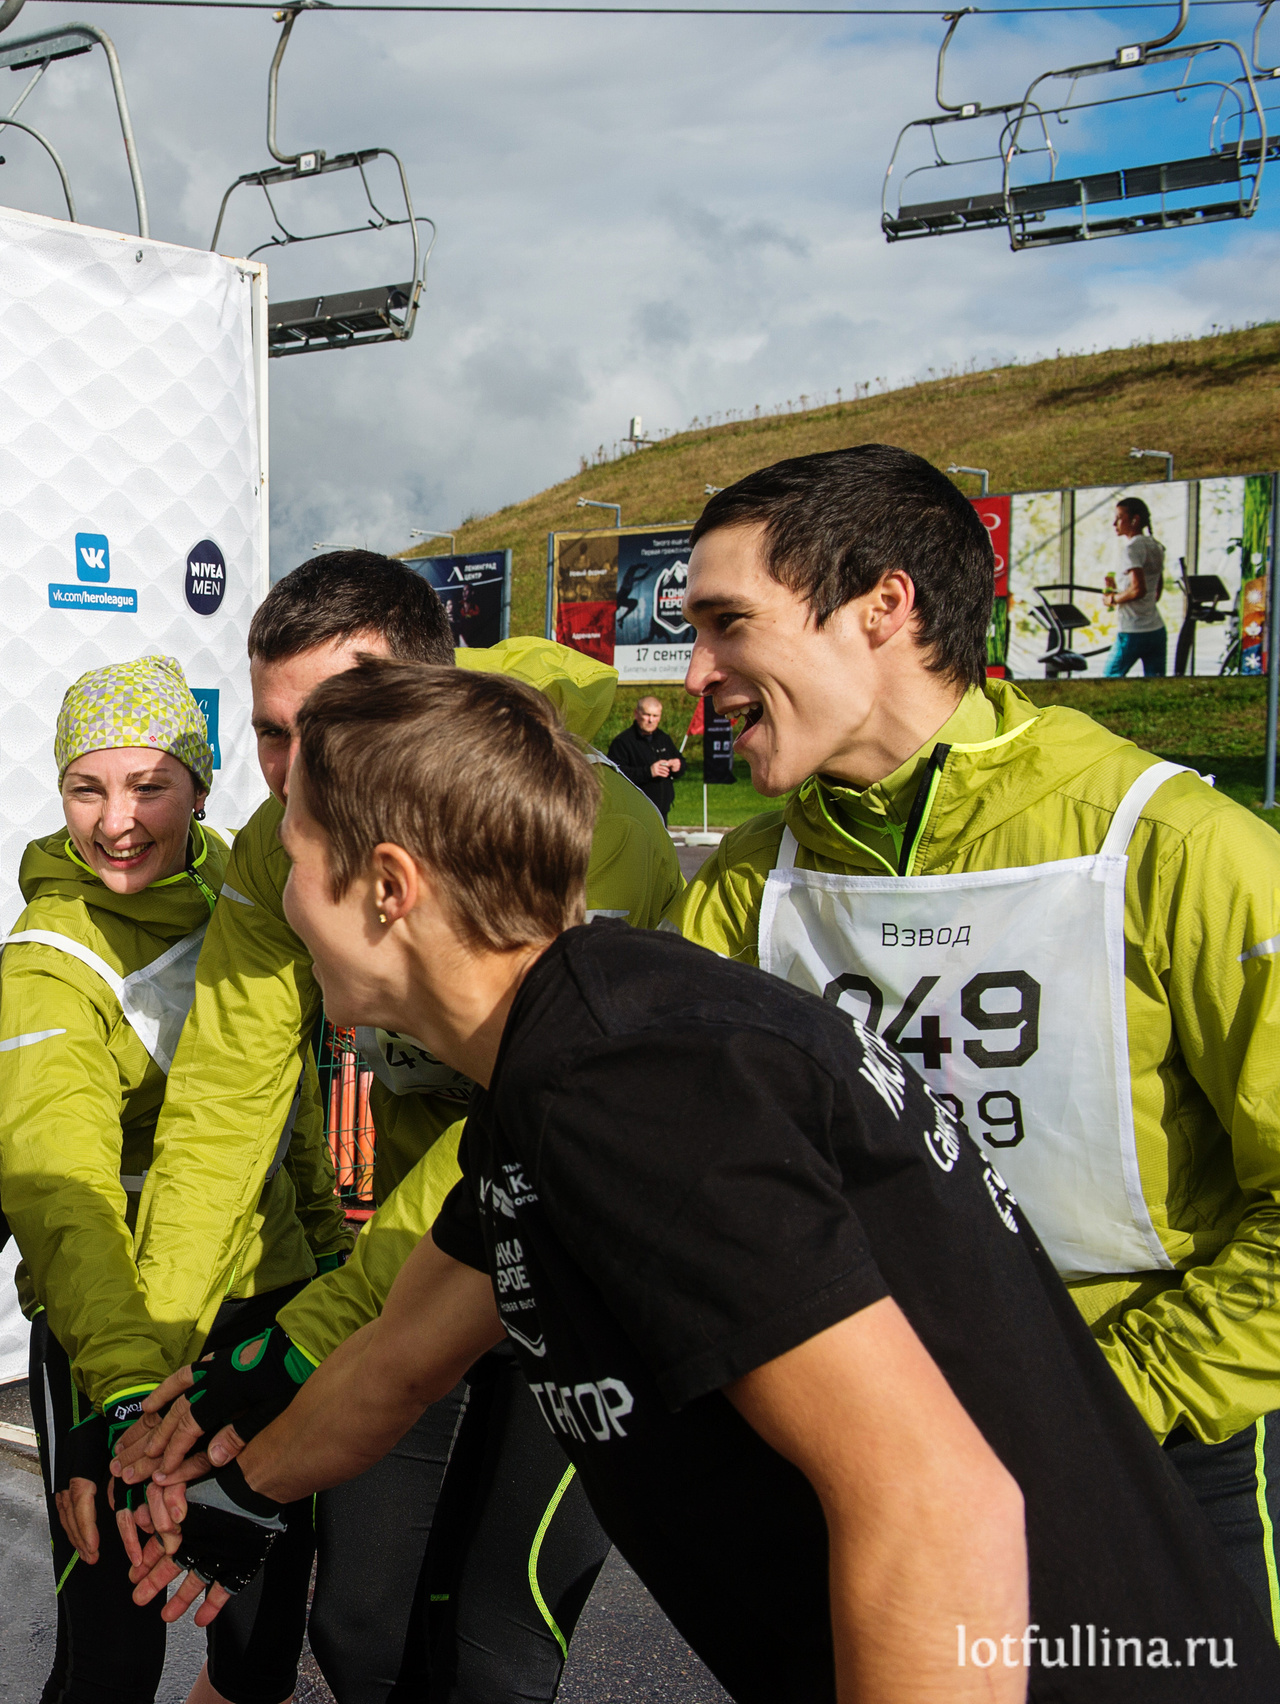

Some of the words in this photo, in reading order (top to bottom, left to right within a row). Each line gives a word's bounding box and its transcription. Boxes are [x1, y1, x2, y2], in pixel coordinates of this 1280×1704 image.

[190, 561, 224, 579] NIVEA
[464, 562, 497, 572] ЛЕНИНГРАД
[464, 572, 482, 581] ЦЕНТР
[192, 579, 220, 596] MEN
[52, 590, 134, 608] vk.com/heroleague
[659, 598, 683, 609] ГЕРО
[636, 647, 649, 661] 17
[653, 649, 692, 661] сентя
[881, 922, 971, 948] Взвод
[823, 970, 1042, 1069] 049
